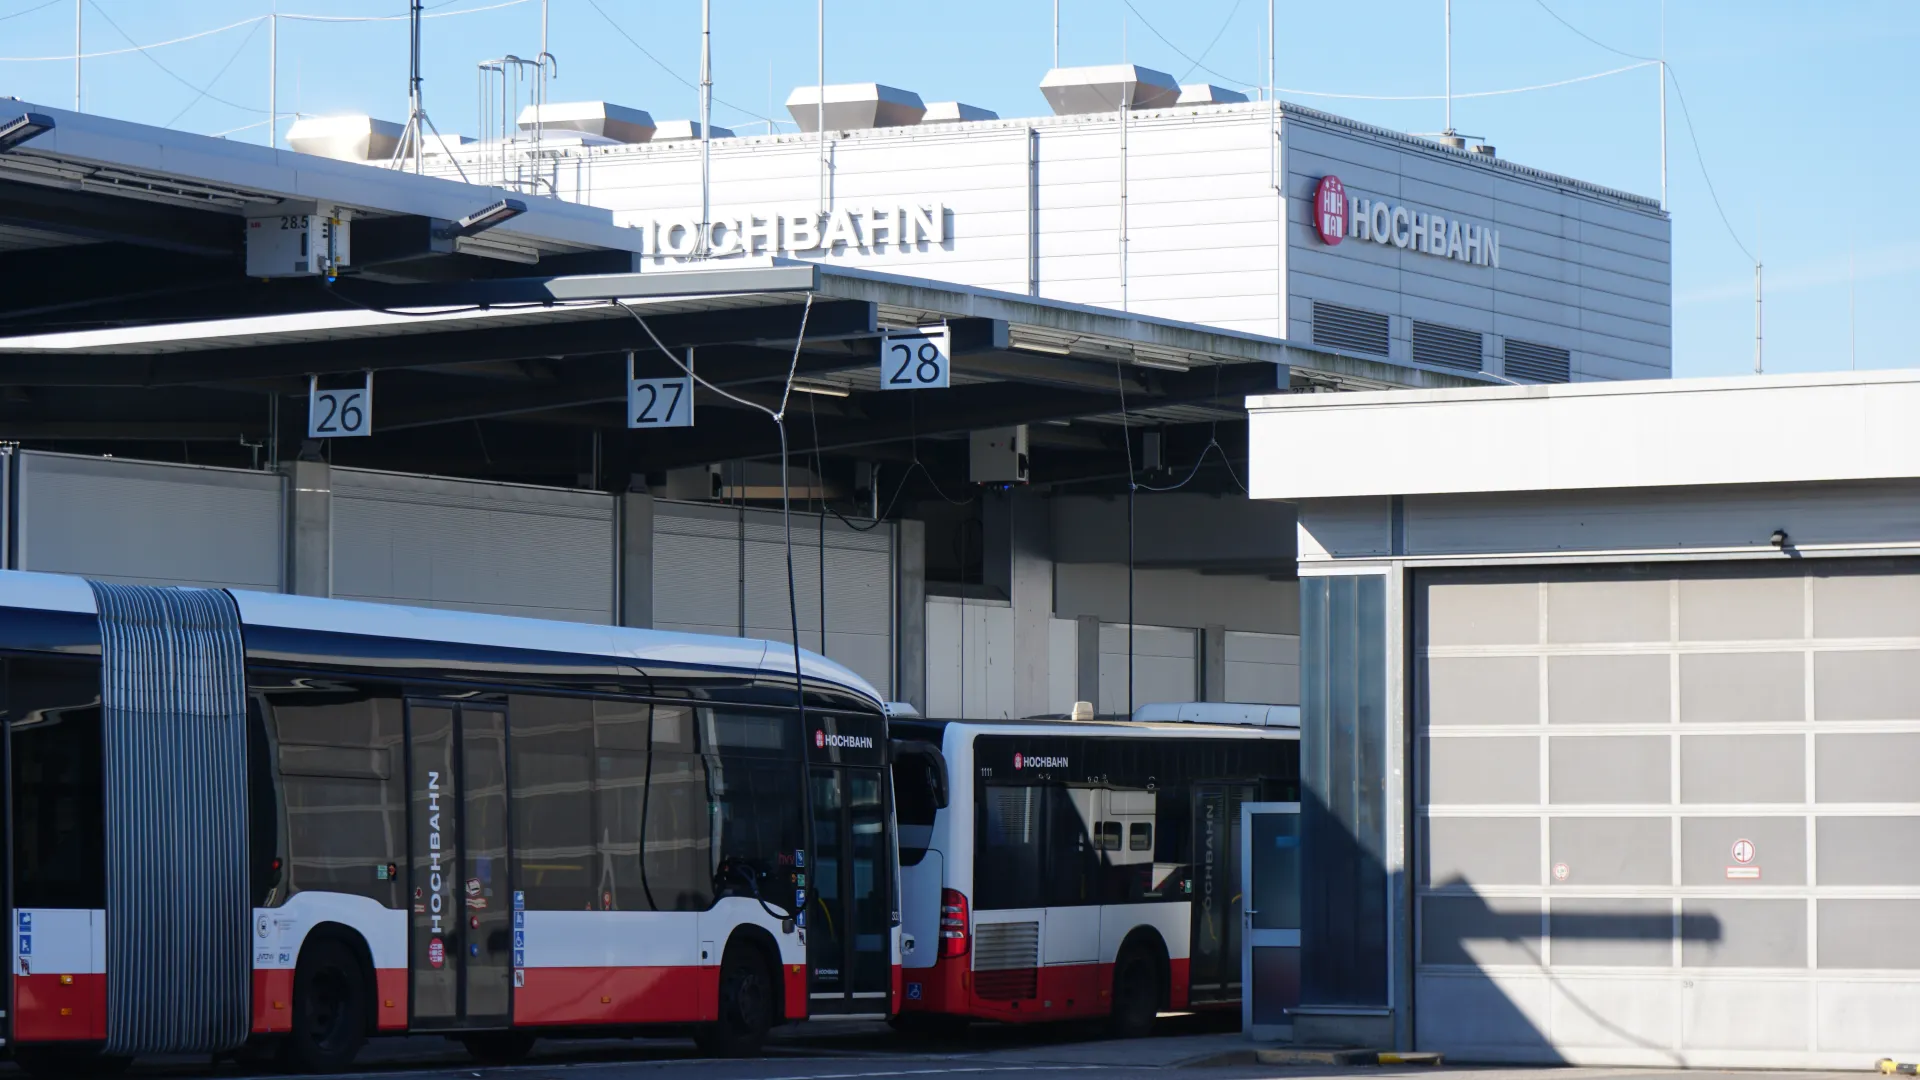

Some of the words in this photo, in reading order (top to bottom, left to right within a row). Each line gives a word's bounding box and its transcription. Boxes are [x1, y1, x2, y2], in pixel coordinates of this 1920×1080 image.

[281, 216, 308, 230] 28.5
[1351, 196, 1500, 269] HOCHBAHN
[890, 342, 940, 384] 28
[317, 393, 363, 432] 26
[636, 383, 684, 423] 27
[825, 734, 873, 749] HOCHBAHN
[981, 767, 993, 777] 1111
[1023, 756, 1069, 768] HOCHBAHN
[428, 771, 442, 933] HOCHBAHN
[1204, 805, 1214, 912] OCHBAHN
